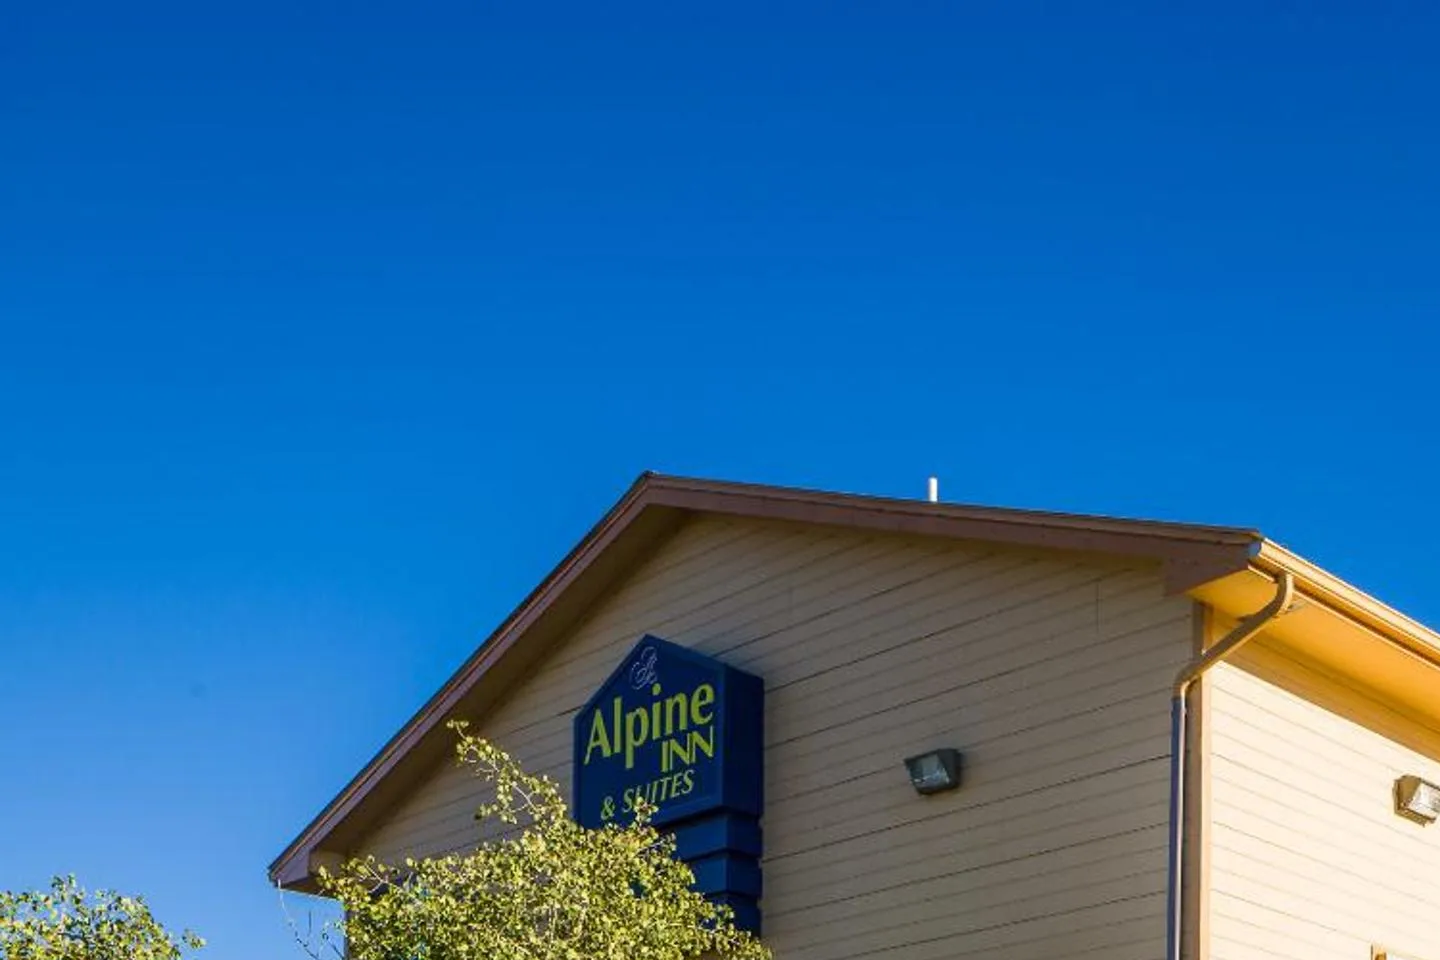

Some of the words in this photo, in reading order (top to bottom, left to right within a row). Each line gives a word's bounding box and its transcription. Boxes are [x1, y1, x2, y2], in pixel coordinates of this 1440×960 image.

[584, 683, 714, 769] Alpine
[660, 726, 714, 772] INN
[600, 796, 616, 820] &
